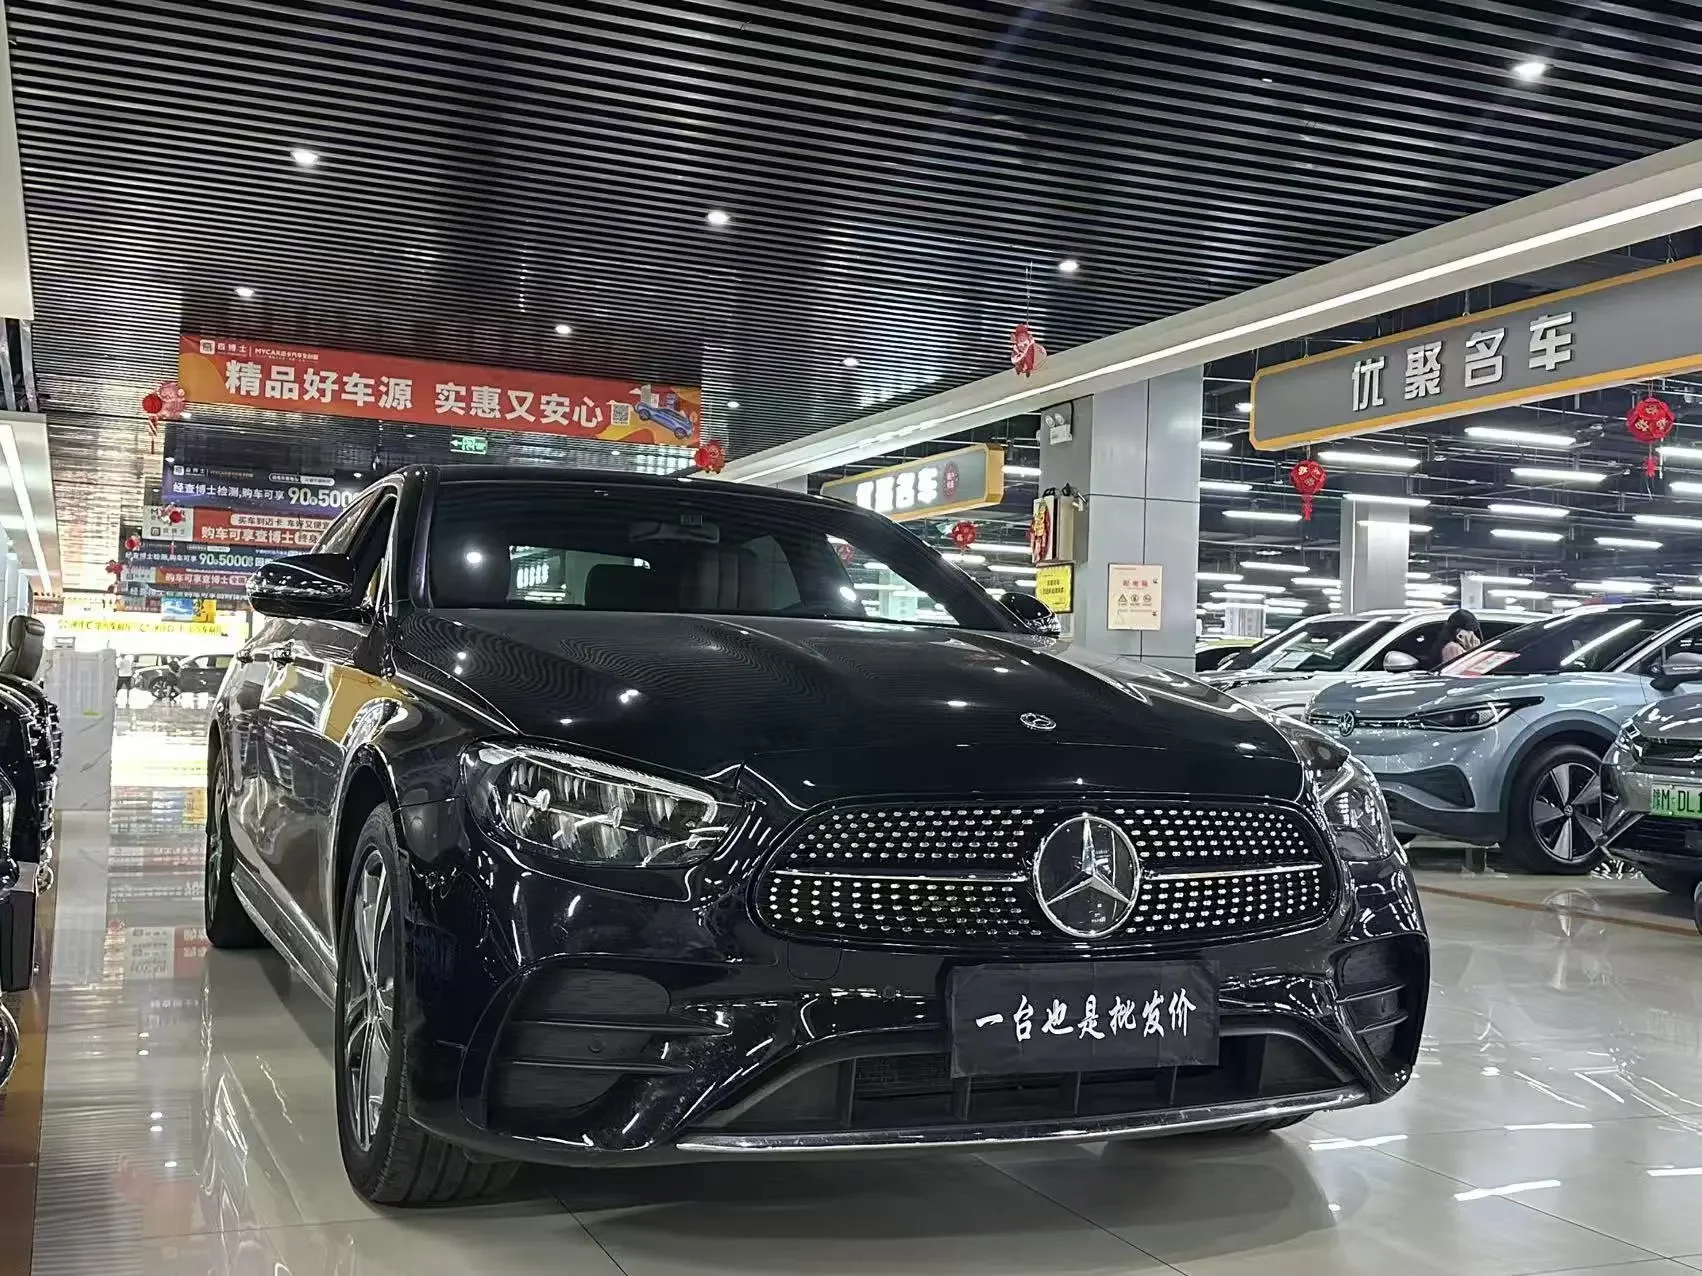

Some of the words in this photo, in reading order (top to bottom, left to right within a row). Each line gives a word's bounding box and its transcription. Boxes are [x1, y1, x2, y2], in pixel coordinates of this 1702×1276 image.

[1351, 311, 1574, 411] 优聚名车
[225, 359, 413, 411] 精品好车源
[435, 382, 604, 428] 实惠又安心
[201, 526, 295, 545] 购车可享查博士
[975, 987, 1197, 1042] 一台也是批发价
